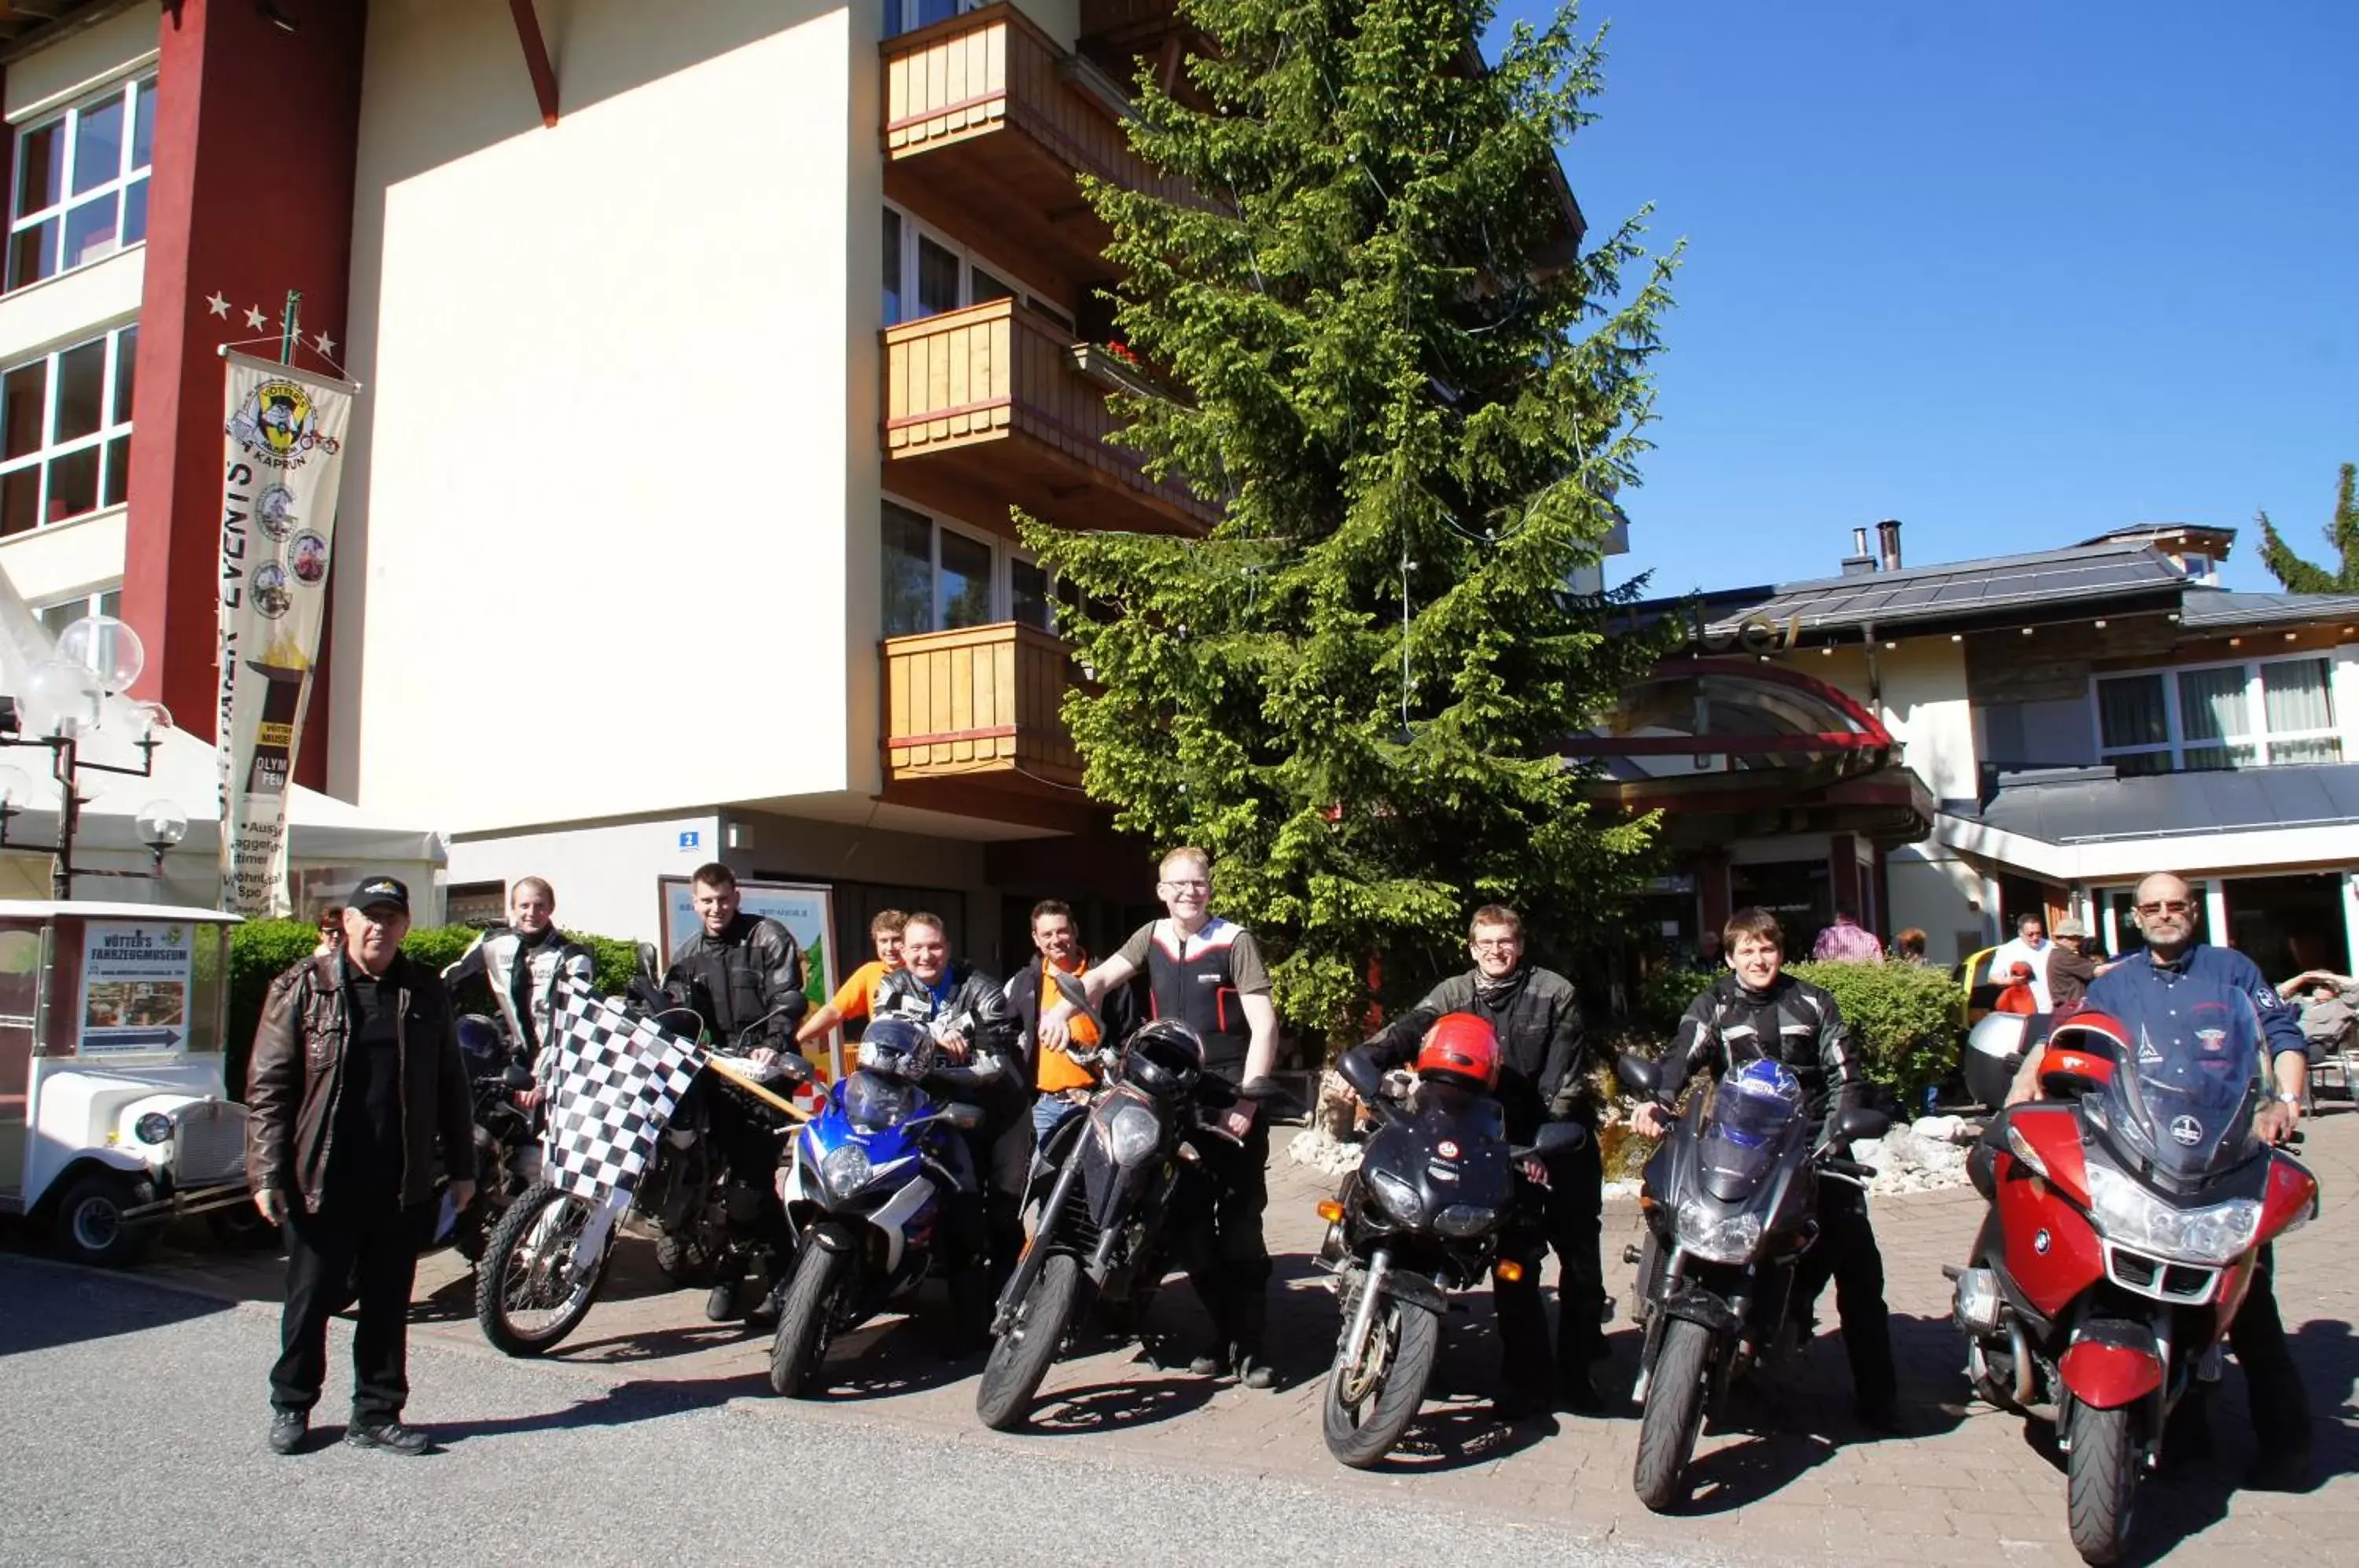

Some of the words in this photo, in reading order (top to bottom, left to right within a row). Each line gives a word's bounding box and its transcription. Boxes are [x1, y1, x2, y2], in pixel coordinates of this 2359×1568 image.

[253, 451, 306, 470] KAPRUN
[223, 462, 252, 609] EVENTS
[685, 834, 693, 845] 2
[90, 948, 188, 961] FAHRZEUGMUSEUM
